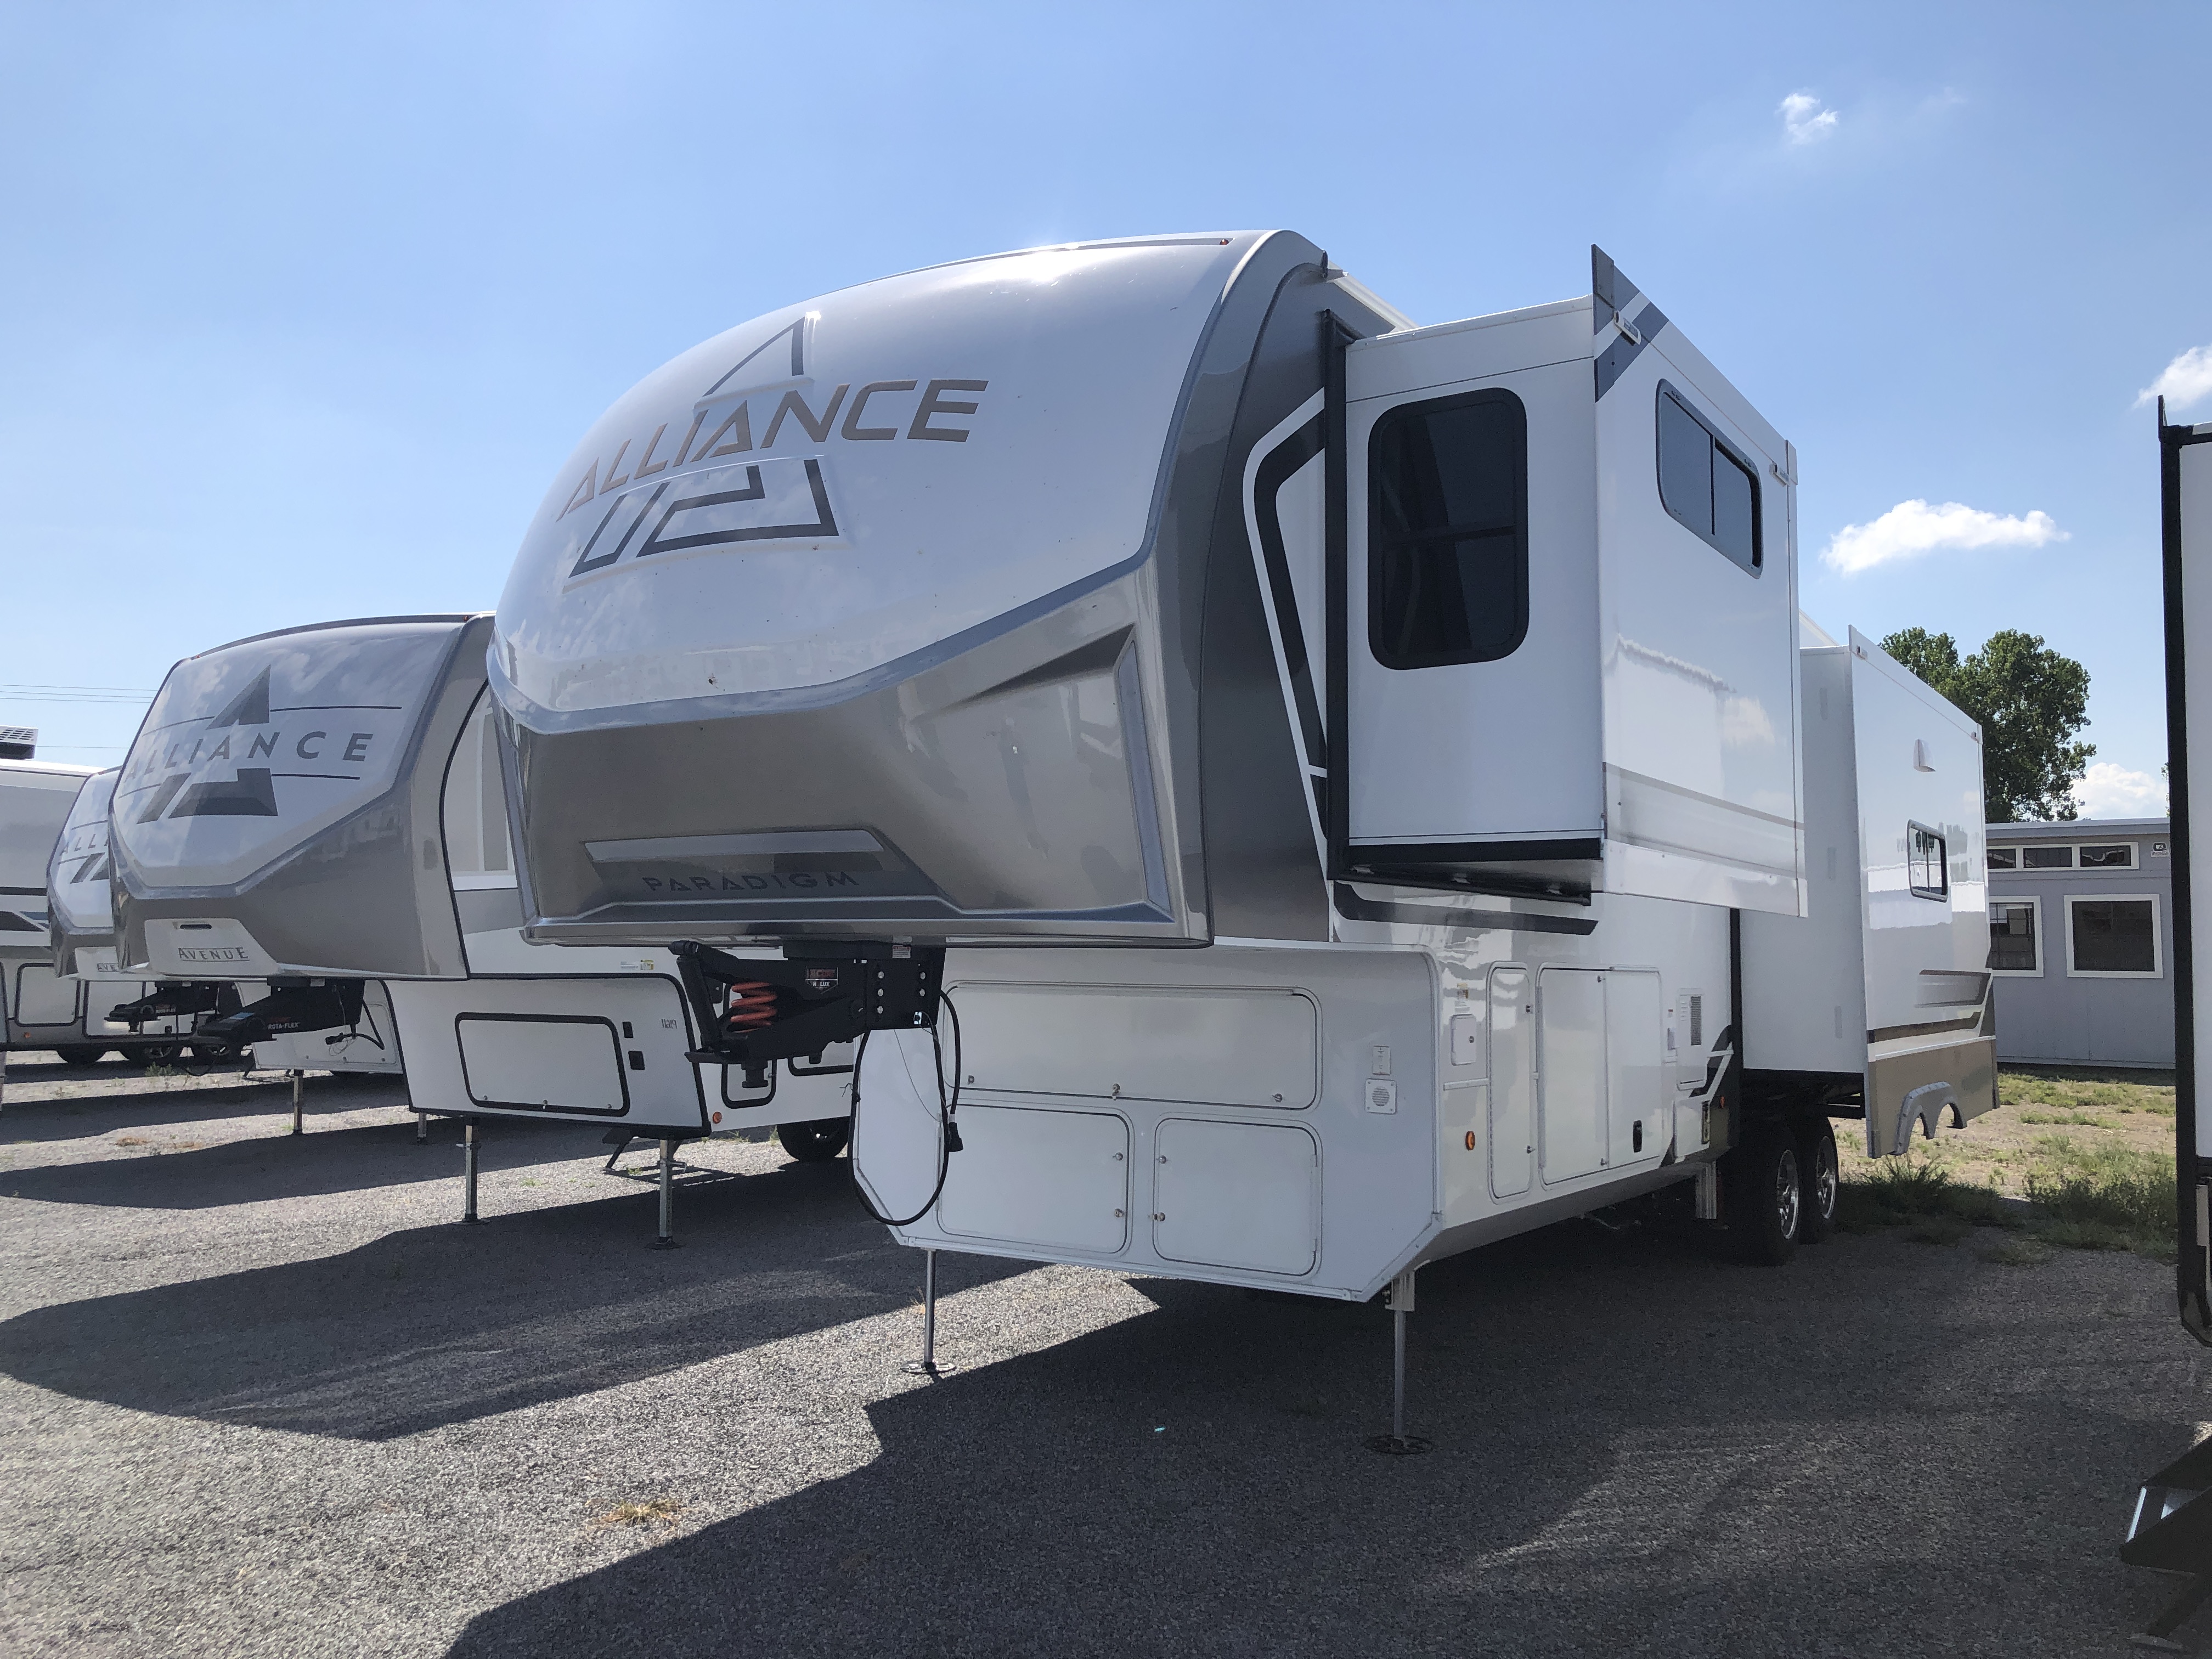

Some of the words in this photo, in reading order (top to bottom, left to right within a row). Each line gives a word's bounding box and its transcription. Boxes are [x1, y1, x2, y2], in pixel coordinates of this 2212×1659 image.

[556, 379, 989, 523] ALLIANCE
[123, 731, 374, 783] ALLIANCE
[642, 871, 860, 891] PARADIGM
[178, 947, 249, 960] AVENUE
